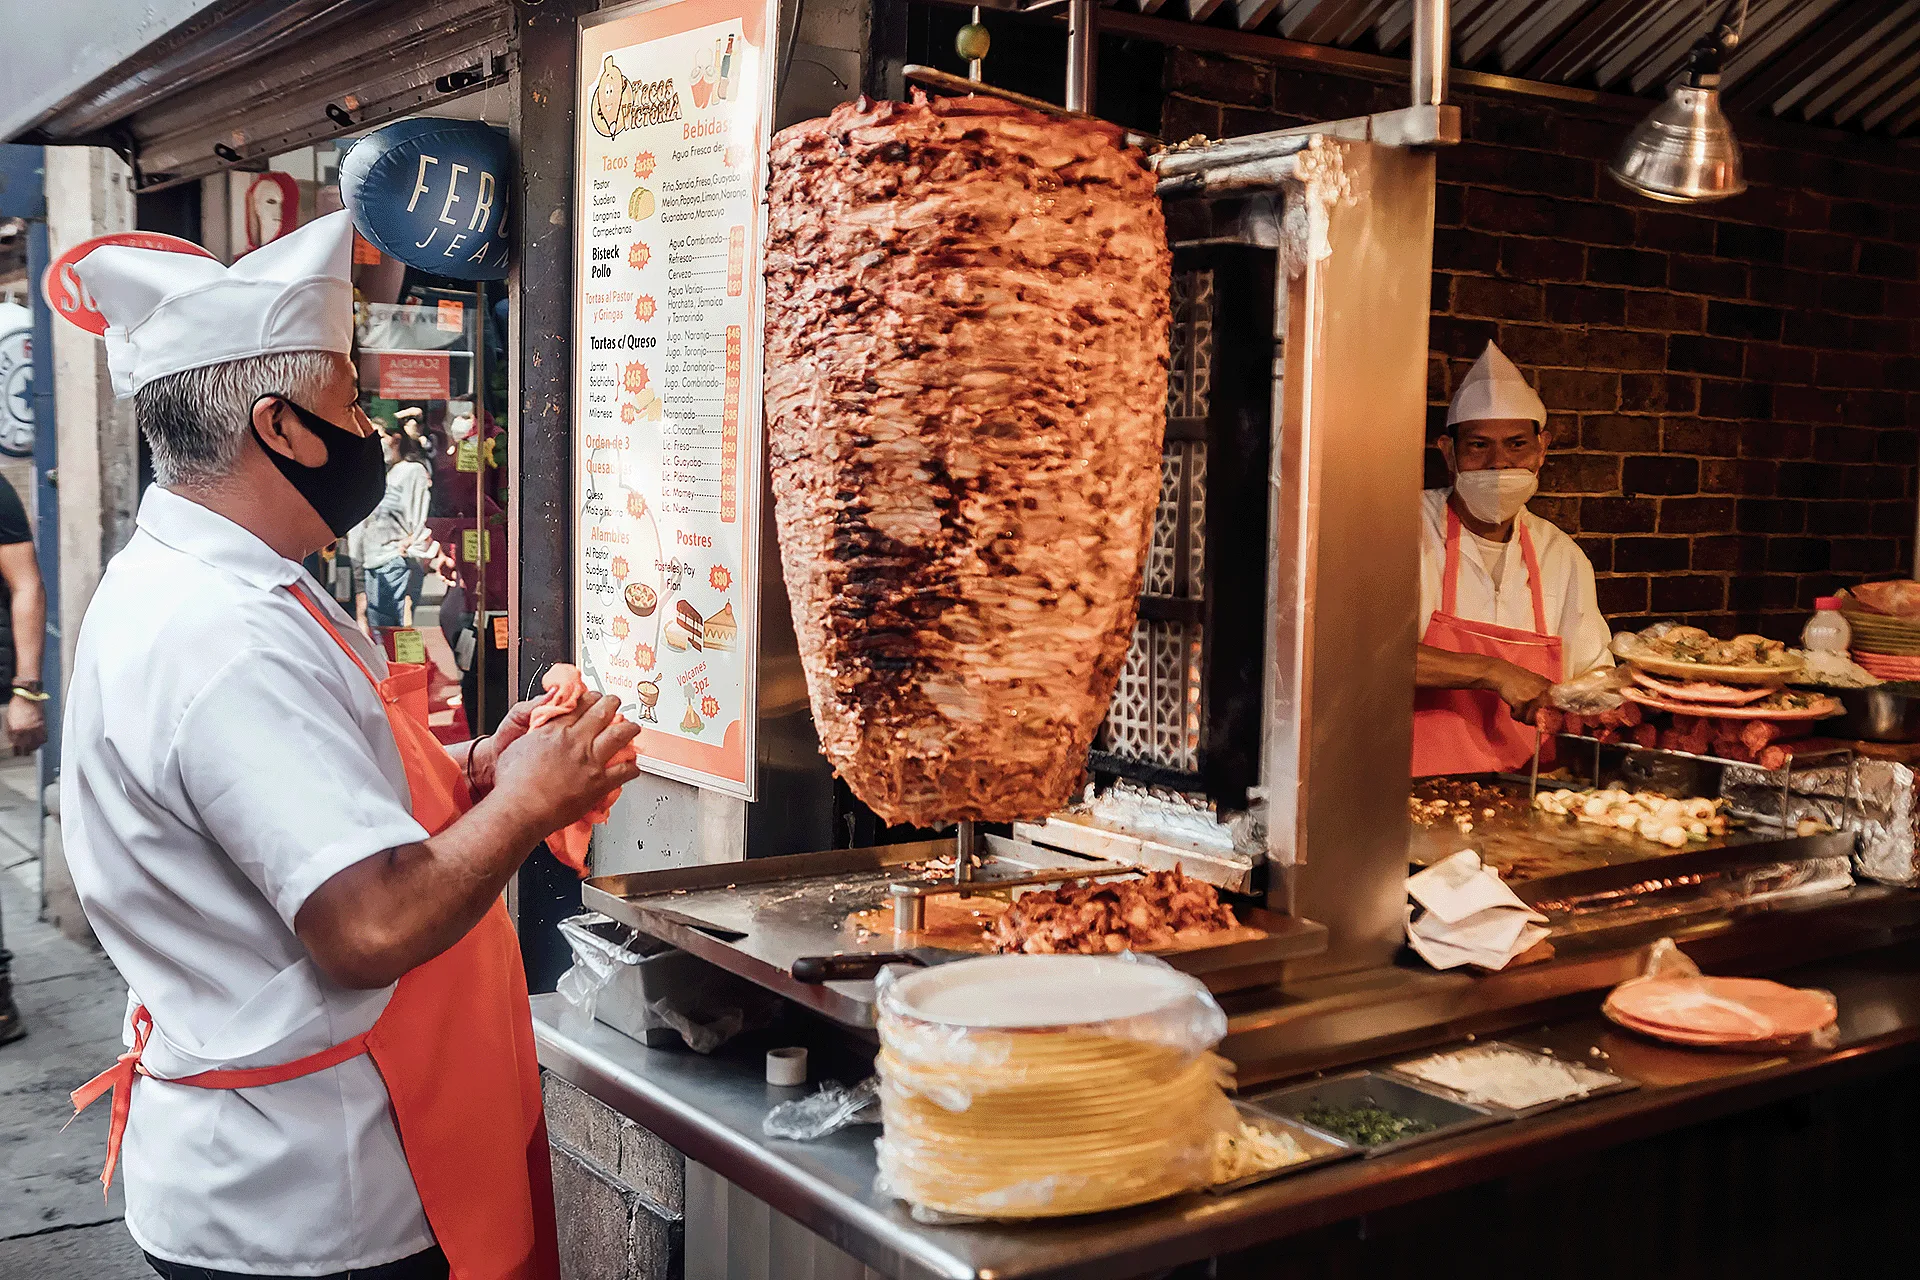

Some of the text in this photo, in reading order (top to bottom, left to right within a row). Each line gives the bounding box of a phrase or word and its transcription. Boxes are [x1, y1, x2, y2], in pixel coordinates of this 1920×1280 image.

[632, 78, 673, 104] Tacos
[683, 116, 728, 140] Bebidas
[672, 150, 689, 161] Agua
[713, 141, 724, 152] de:
[602, 156, 628, 171] Tacos
[593, 180, 610, 190] Pastor
[593, 194, 616, 206] Suadero
[592, 209, 621, 223] Longaniza
[669, 238, 685, 251] Agua
[592, 244, 620, 260] Bisteck
[668, 252, 692, 264] Refresco
[591, 264, 611, 278] Pollo
[668, 268, 692, 280] Cerveza
[586, 290, 633, 304] Tortas al Pastor
[667, 286, 683, 298] Agua
[668, 296, 723, 309] Horchata, Jamaica
[593, 308, 624, 324] y Gringas
[667, 311, 704, 326] y Tamarindo
[590, 334, 657, 350] Tortas c/ Queso
[667, 328, 740, 343] Jugo. Naranja $45
[666, 344, 740, 359] Jugo. Toranja $45
[665, 360, 740, 374] Jugo. Zanahoria $45
[589, 376, 614, 387] Salchicha
[626, 370, 641, 387] $65
[664, 378, 680, 390] Jugo.
[589, 392, 607, 402] Huevo
[664, 392, 694, 403] Limonada
[589, 407, 613, 418] Milanesa
[663, 408, 696, 420] Naranjada
[723, 424, 736, 437] $40
[586, 434, 630, 449] Orden de 3
[673, 439, 690, 450] Fresa
[723, 441, 736, 453] $50
[673, 455, 702, 468] Guayaba
[722, 457, 736, 470] $50
[673, 488, 695, 500] Mamey
[722, 489, 735, 502] $55
[673, 502, 689, 513] Nuez
[721, 505, 735, 518] $55
[591, 527, 630, 544] Alambres
[676, 529, 712, 548] Postres
[585, 547, 609, 560] Al Pastor
[586, 563, 609, 577] Suadero
[683, 562, 695, 578] Pay
[586, 580, 615, 594] Longaniza
[666, 578, 681, 591] Flan
[586, 612, 605, 626] Bisteck
[586, 628, 600, 640] Pollo
[610, 654, 629, 668] Queso
[605, 671, 633, 688] Fundido
[676, 660, 707, 687] Volcanes
[693, 675, 710, 695] 3pz
